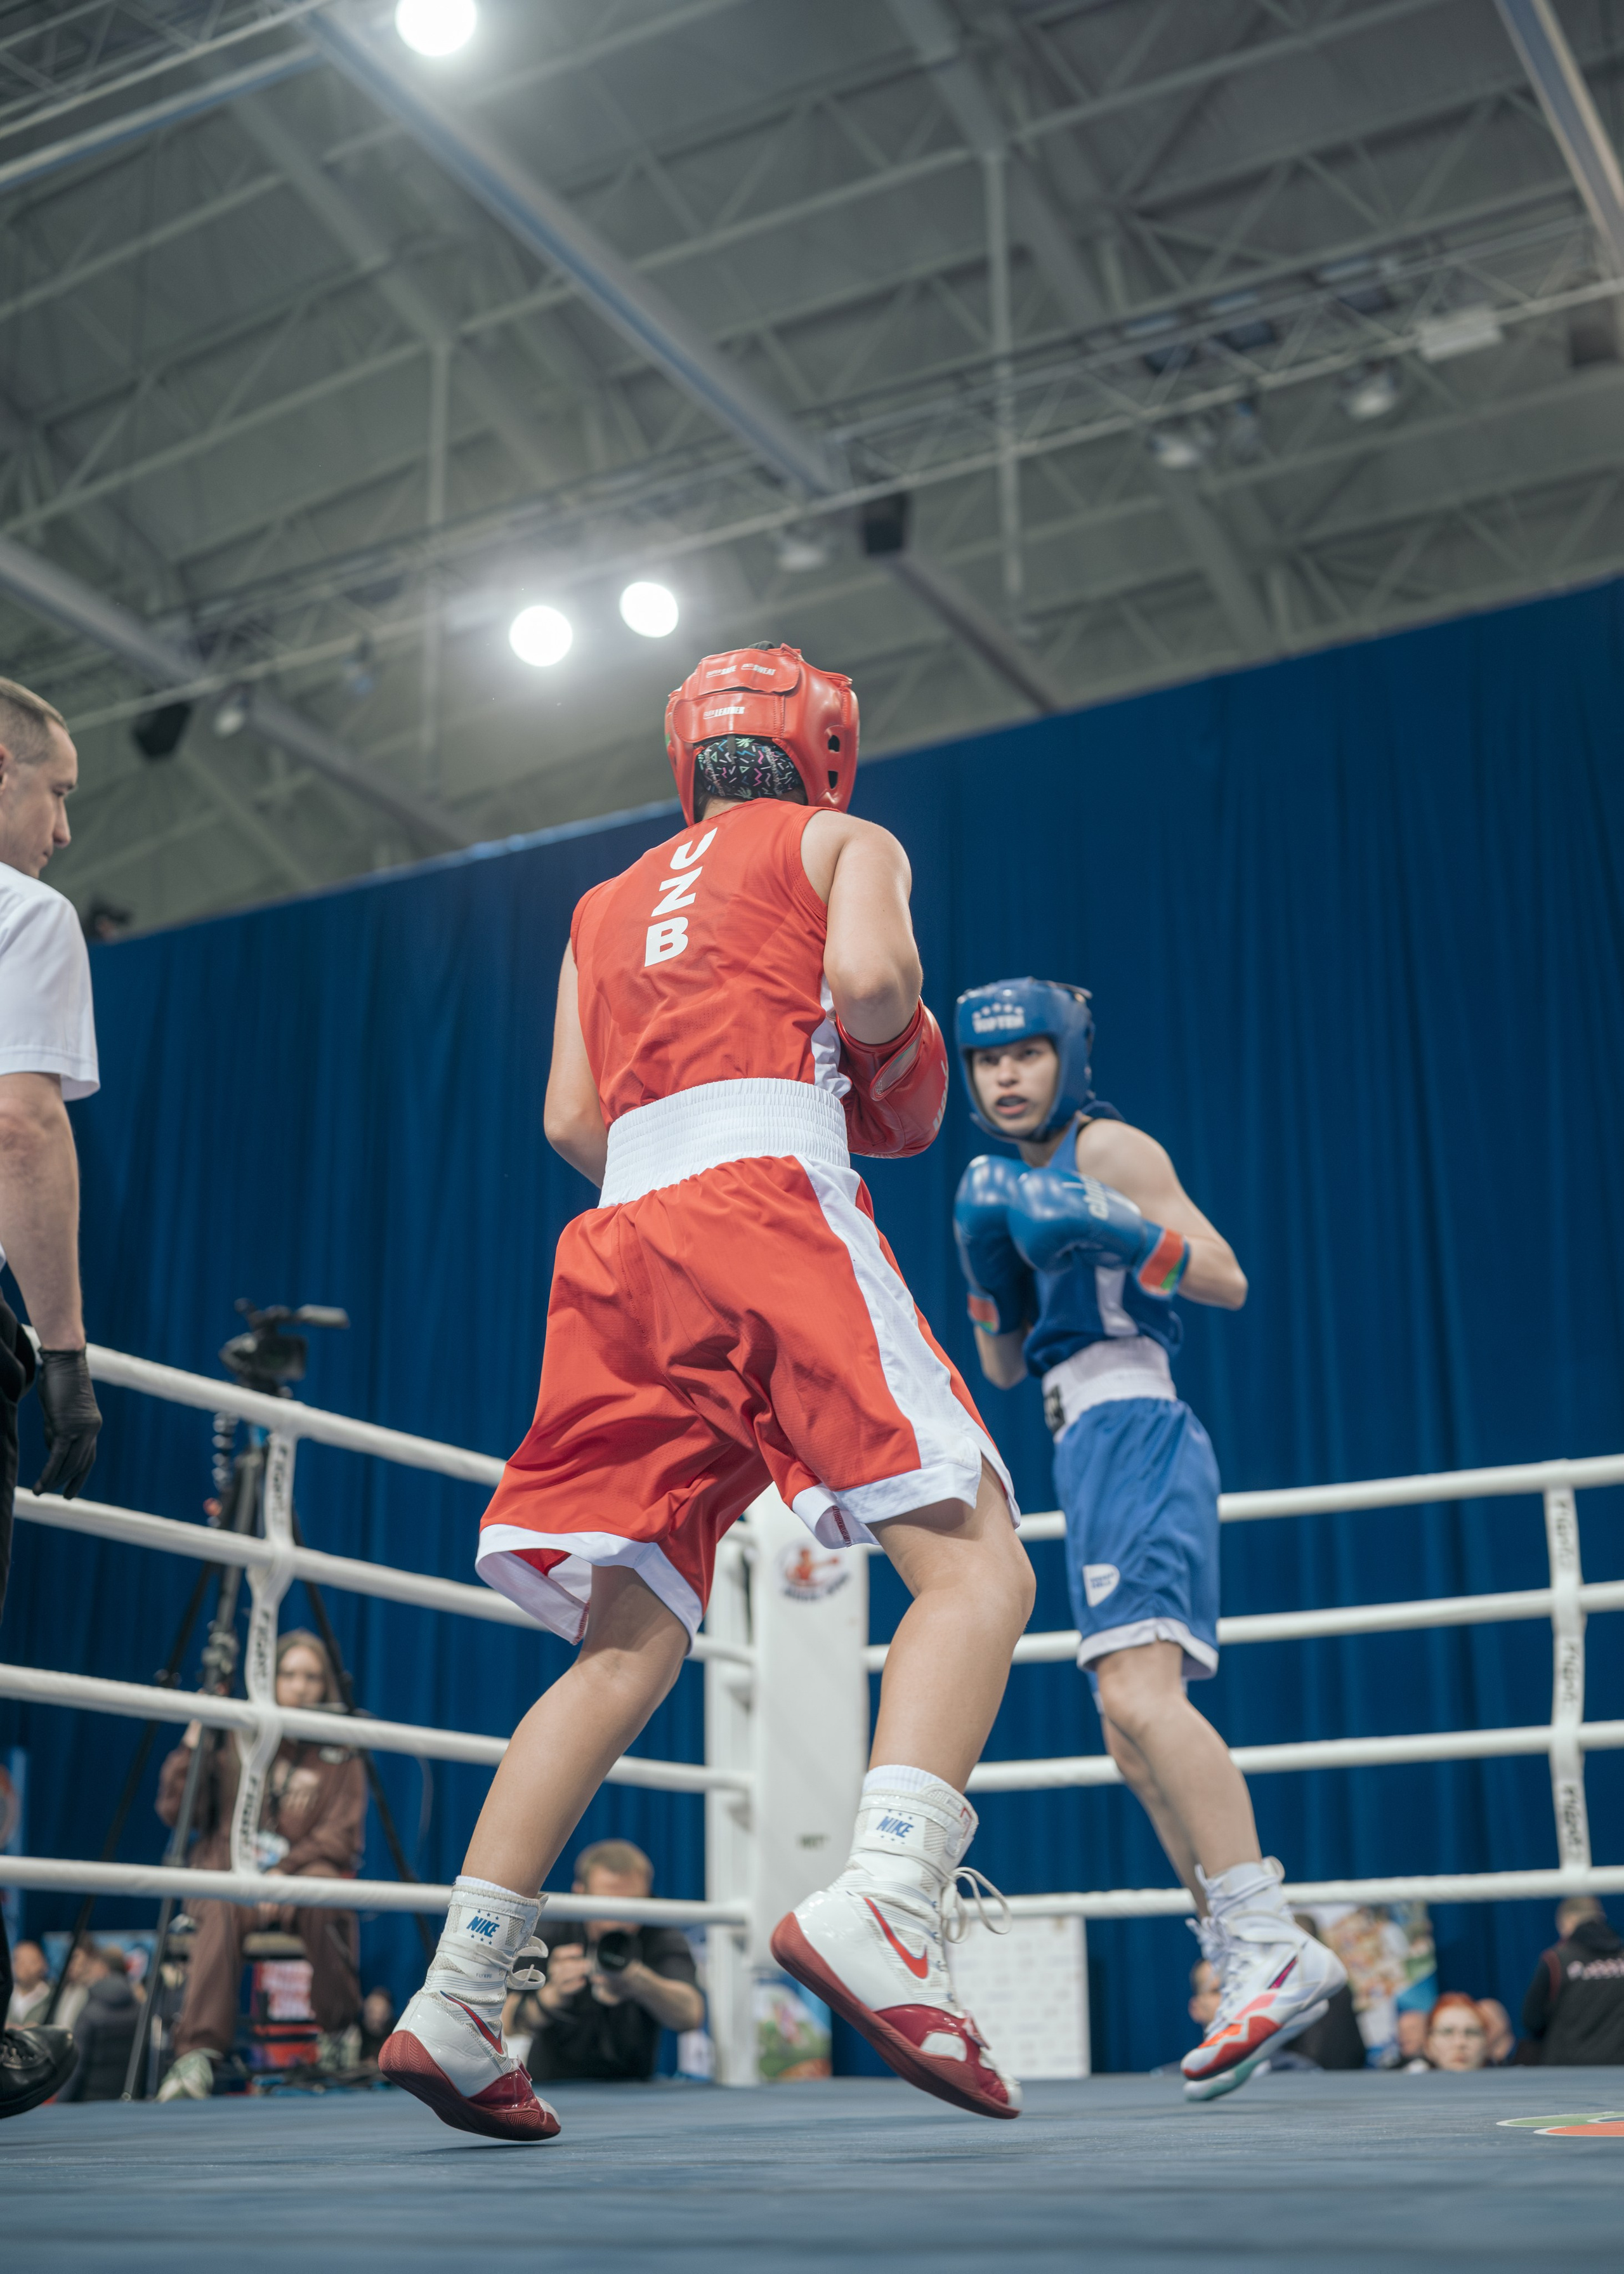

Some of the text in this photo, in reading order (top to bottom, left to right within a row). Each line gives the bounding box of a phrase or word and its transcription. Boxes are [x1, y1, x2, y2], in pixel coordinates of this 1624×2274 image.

[645, 827, 718, 967] UZB
[876, 1815, 914, 1837] NIKE
[466, 1916, 500, 1938] NIKE
